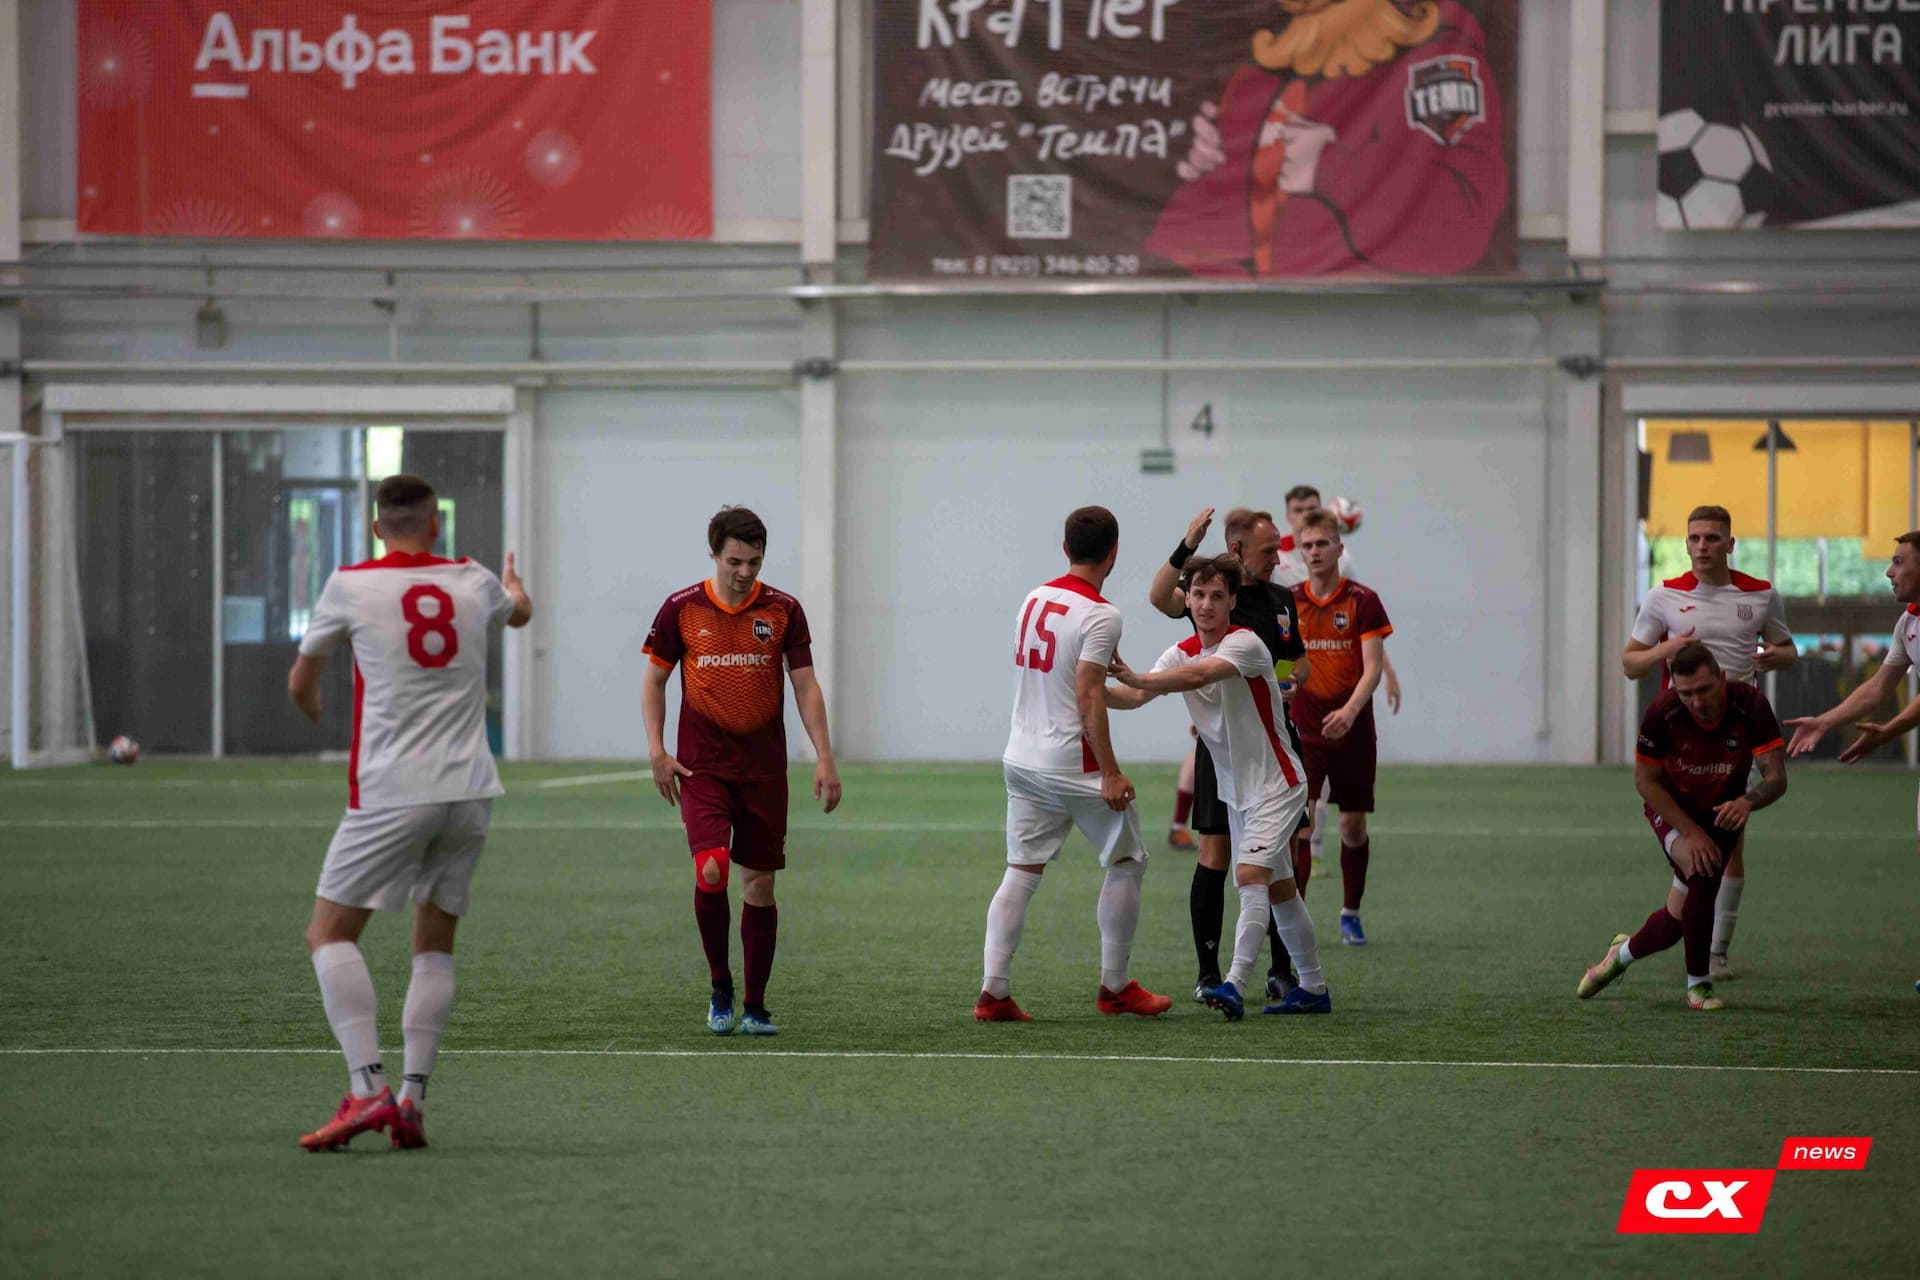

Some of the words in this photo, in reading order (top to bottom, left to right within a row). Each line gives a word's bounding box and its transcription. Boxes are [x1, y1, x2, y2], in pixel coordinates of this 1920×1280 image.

[430, 16, 598, 75] Банк
[1774, 24, 1903, 65] ЛИГА
[1190, 401, 1214, 439] 4
[401, 584, 459, 669] 8
[1016, 597, 1071, 673] 15
